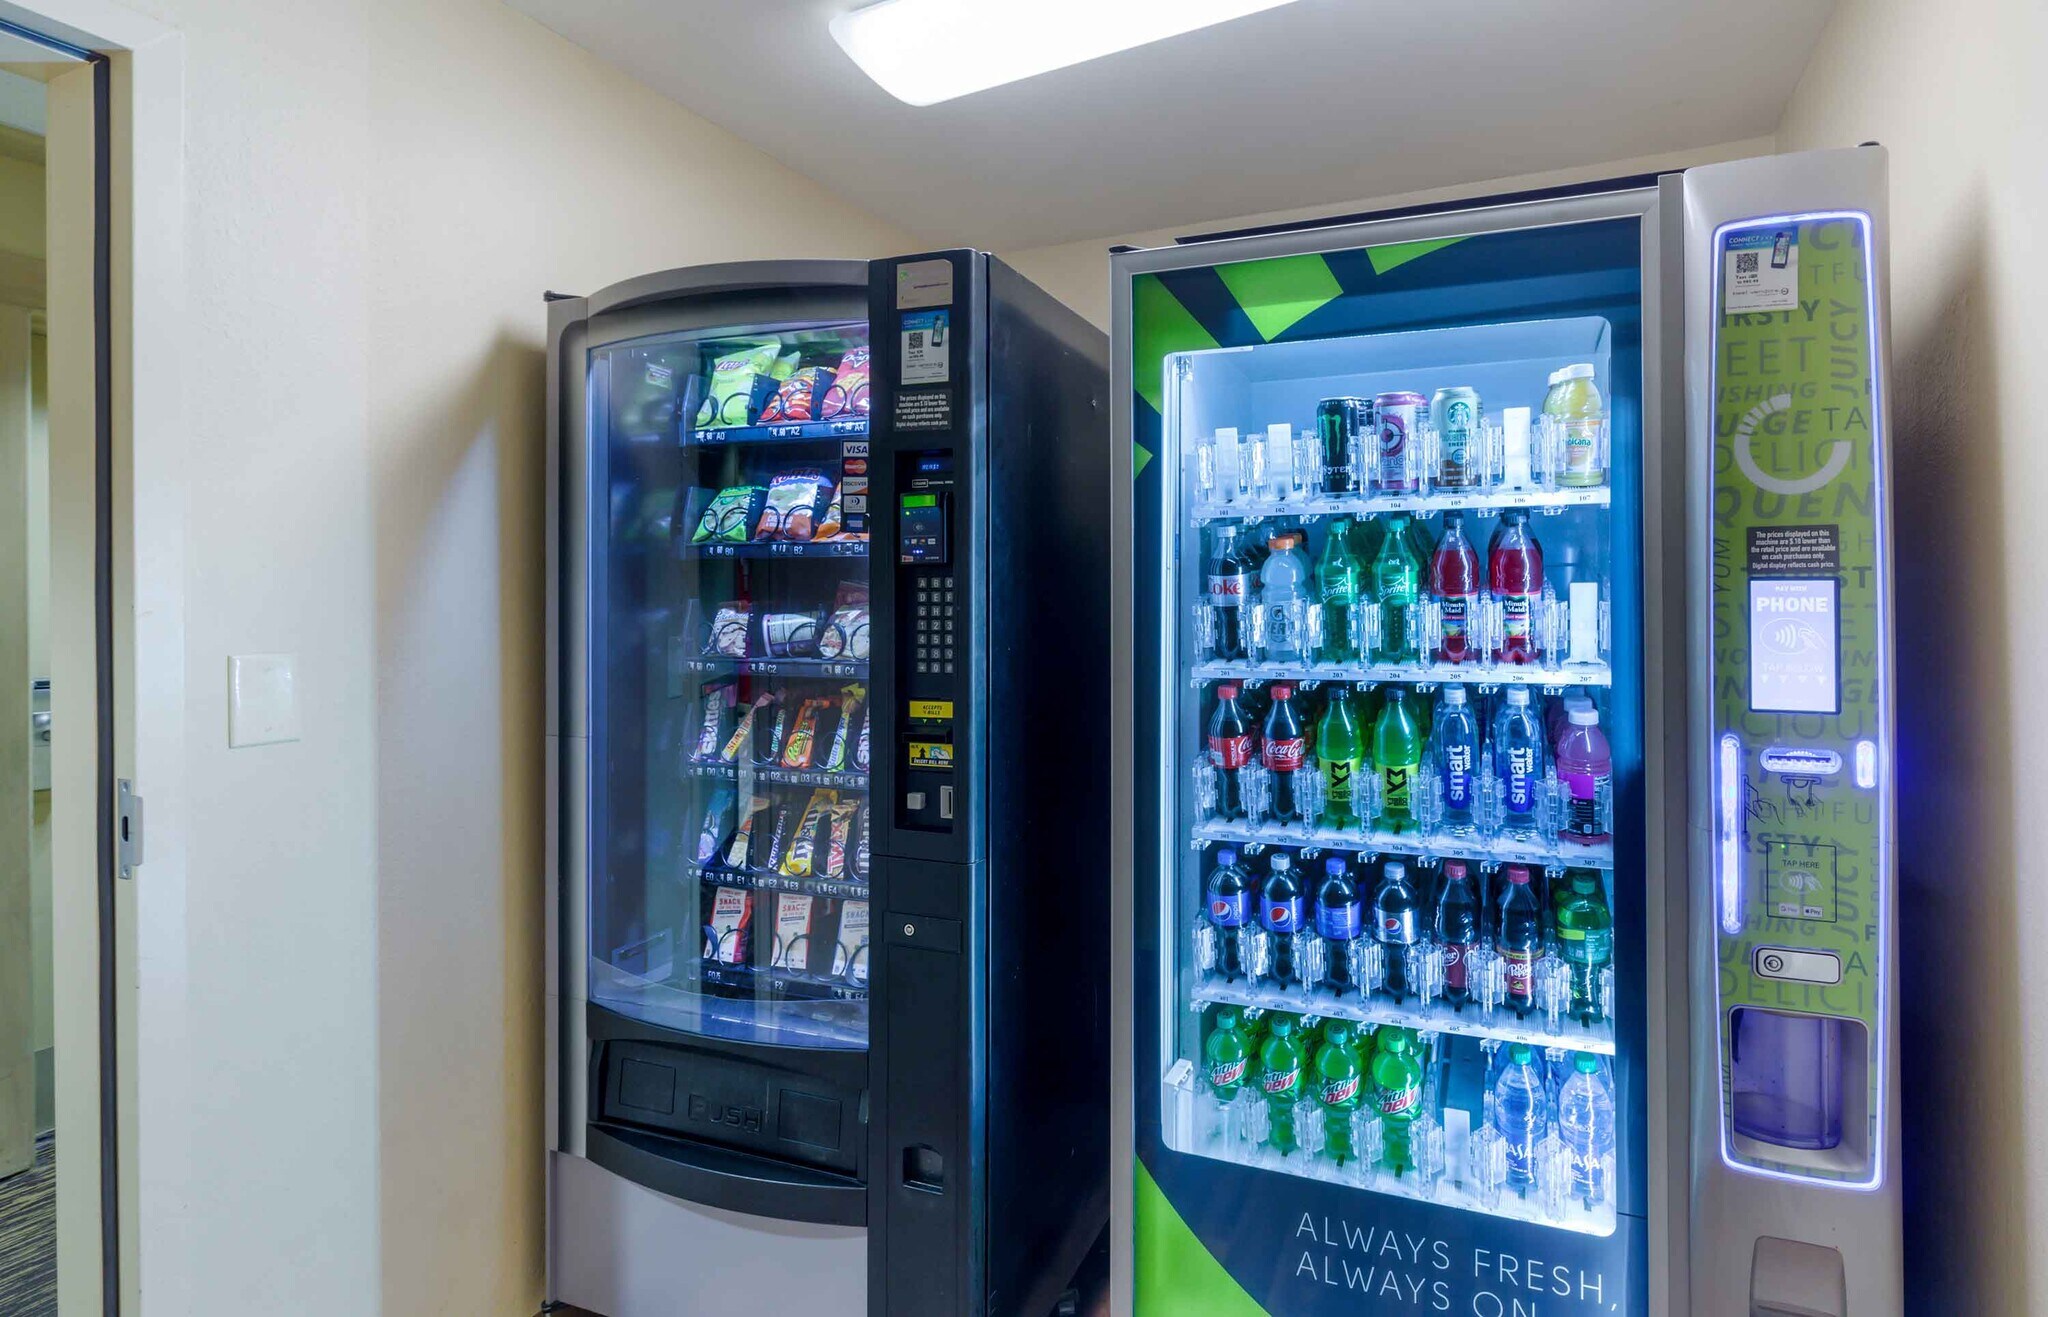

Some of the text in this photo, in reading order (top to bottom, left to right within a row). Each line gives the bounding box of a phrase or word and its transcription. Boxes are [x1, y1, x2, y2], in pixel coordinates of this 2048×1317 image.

[1830, 299, 1858, 399] JUICY
[791, 427, 799, 435] A2
[1767, 531, 1783, 539] prices
[1785, 530, 1810, 538] displayed
[1322, 583, 1350, 598] Sprite
[1380, 583, 1408, 597] Sprite
[1504, 600, 1527, 608] Minute
[1756, 597, 1829, 612] PHONE
[768, 665, 777, 674] C2
[845, 666, 854, 675] C4
[1447, 745, 1464, 801] smart
[1511, 747, 1534, 804] smart water
[1583, 859, 1595, 867] 307
[1782, 859, 1820, 869] TAP HERE
[705, 873, 837, 895] E0 E1 E2 E3 E4
[775, 980, 783, 990] F2
[689, 1093, 763, 1133] PUSH
[1296, 1212, 1617, 1311] ALWAYS FRESH,
[1296, 1251, 1536, 1317] ALWAYS ON
